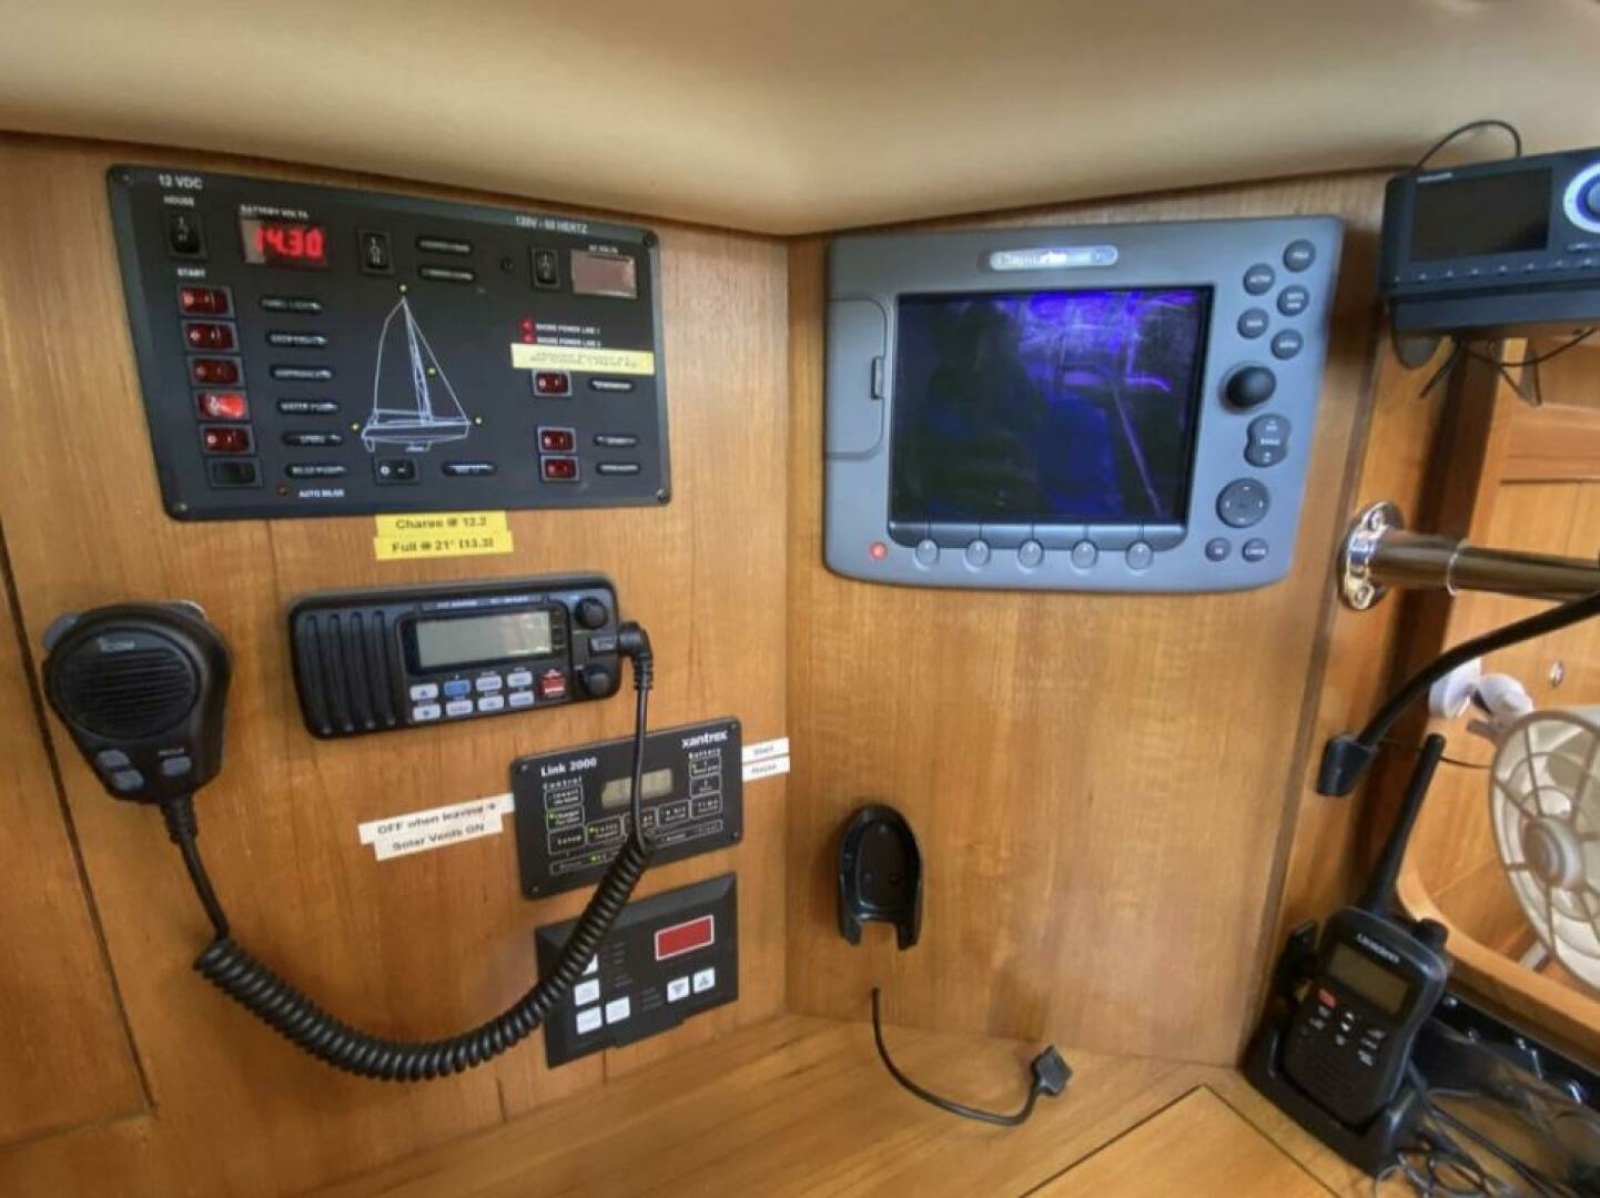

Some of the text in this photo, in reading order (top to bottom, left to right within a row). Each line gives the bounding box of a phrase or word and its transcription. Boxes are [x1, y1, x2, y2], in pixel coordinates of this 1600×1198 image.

[174, 175, 203, 190] VDC
[391, 541, 418, 553] Full
[540, 756, 598, 778] Link 2000
